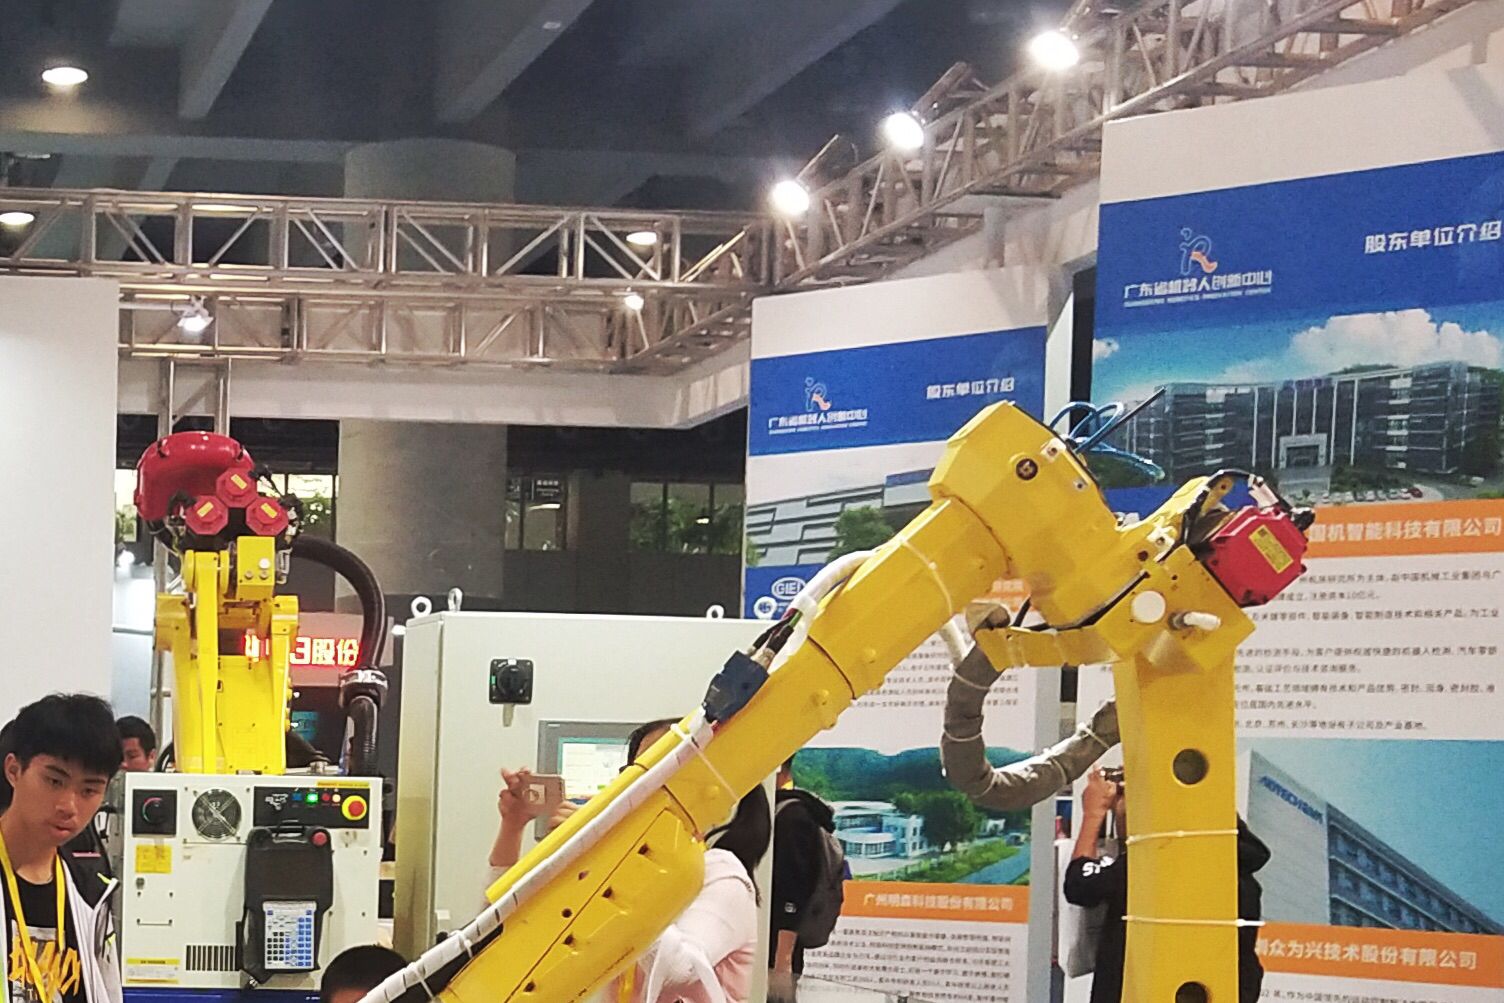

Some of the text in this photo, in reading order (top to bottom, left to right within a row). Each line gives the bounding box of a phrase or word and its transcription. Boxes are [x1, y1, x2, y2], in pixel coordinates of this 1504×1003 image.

[1363, 220, 1502, 254] 股东单位介绍
